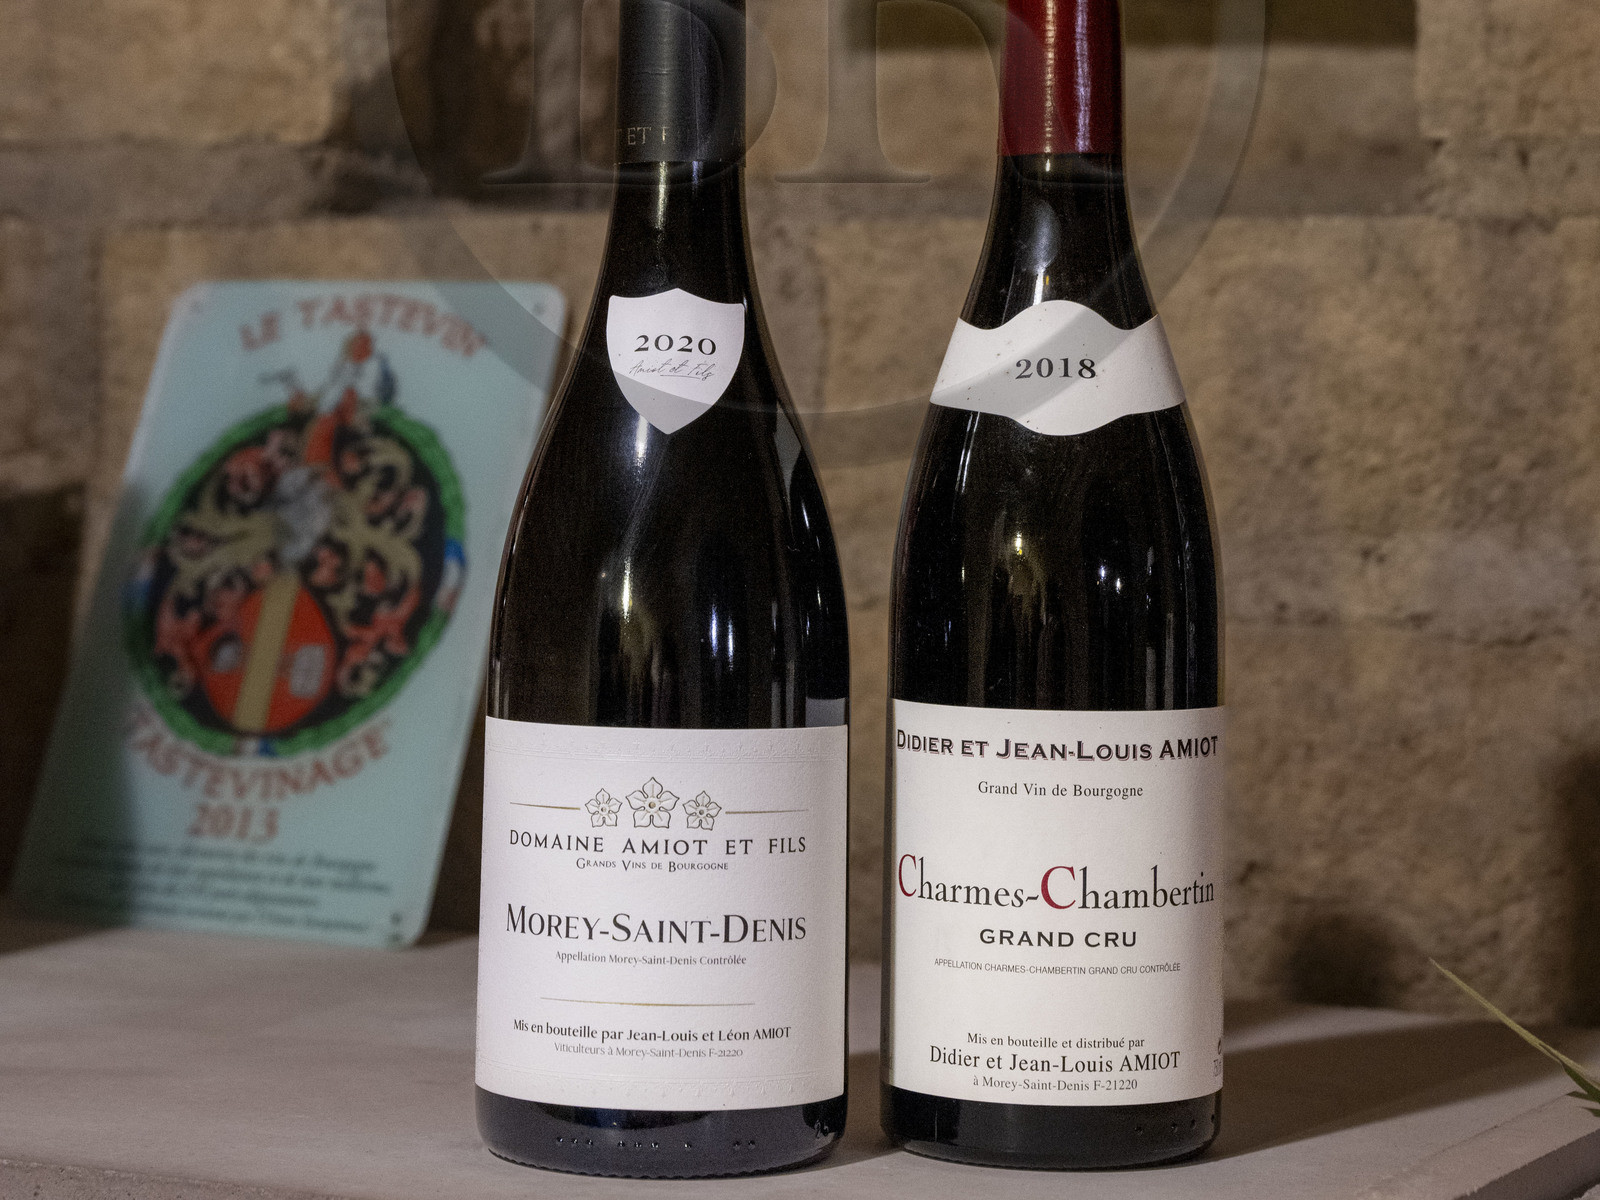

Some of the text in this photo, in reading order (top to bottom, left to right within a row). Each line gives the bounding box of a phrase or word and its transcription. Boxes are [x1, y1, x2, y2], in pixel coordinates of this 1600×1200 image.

[241, 294, 489, 358] LE TASTEVIN
[634, 334, 717, 356] 2020
[1015, 357, 1097, 379] 2018
[132, 712, 391, 798] TASTEVINAGE
[961, 740, 988, 757] ET
[1159, 735, 1218, 760] AMIOT
[978, 780, 1143, 800] Grand Vin de Bourgogne
[510, 829, 806, 855] DOMAINE AMIOT ET FILS
[651, 862, 663, 870] DE
[898, 853, 1214, 909] Charmes-Chambertin
[979, 929, 1137, 947] GRAND CRU
[555, 951, 747, 967] Appellation Morey-Saint-Denis Contrôlée
[934, 958, 1181, 975] APPELLATION CHARMES-CHAMBERTIN GRAND CRU CONTRÔLÉE
[513, 1019, 791, 1044] Mis en bouteille par Jean-Louis et Léon AMIOT
[967, 1033, 1145, 1052] Mis en bouteille et distribué par
[554, 1042, 743, 1059] Viticulteurs à Morey-Saint-Denis F-21220
[930, 1045, 1181, 1073] Didier et Jean-Louis AMIOT
[973, 1076, 1138, 1092] à Morey-Saint-Denis F-21220
